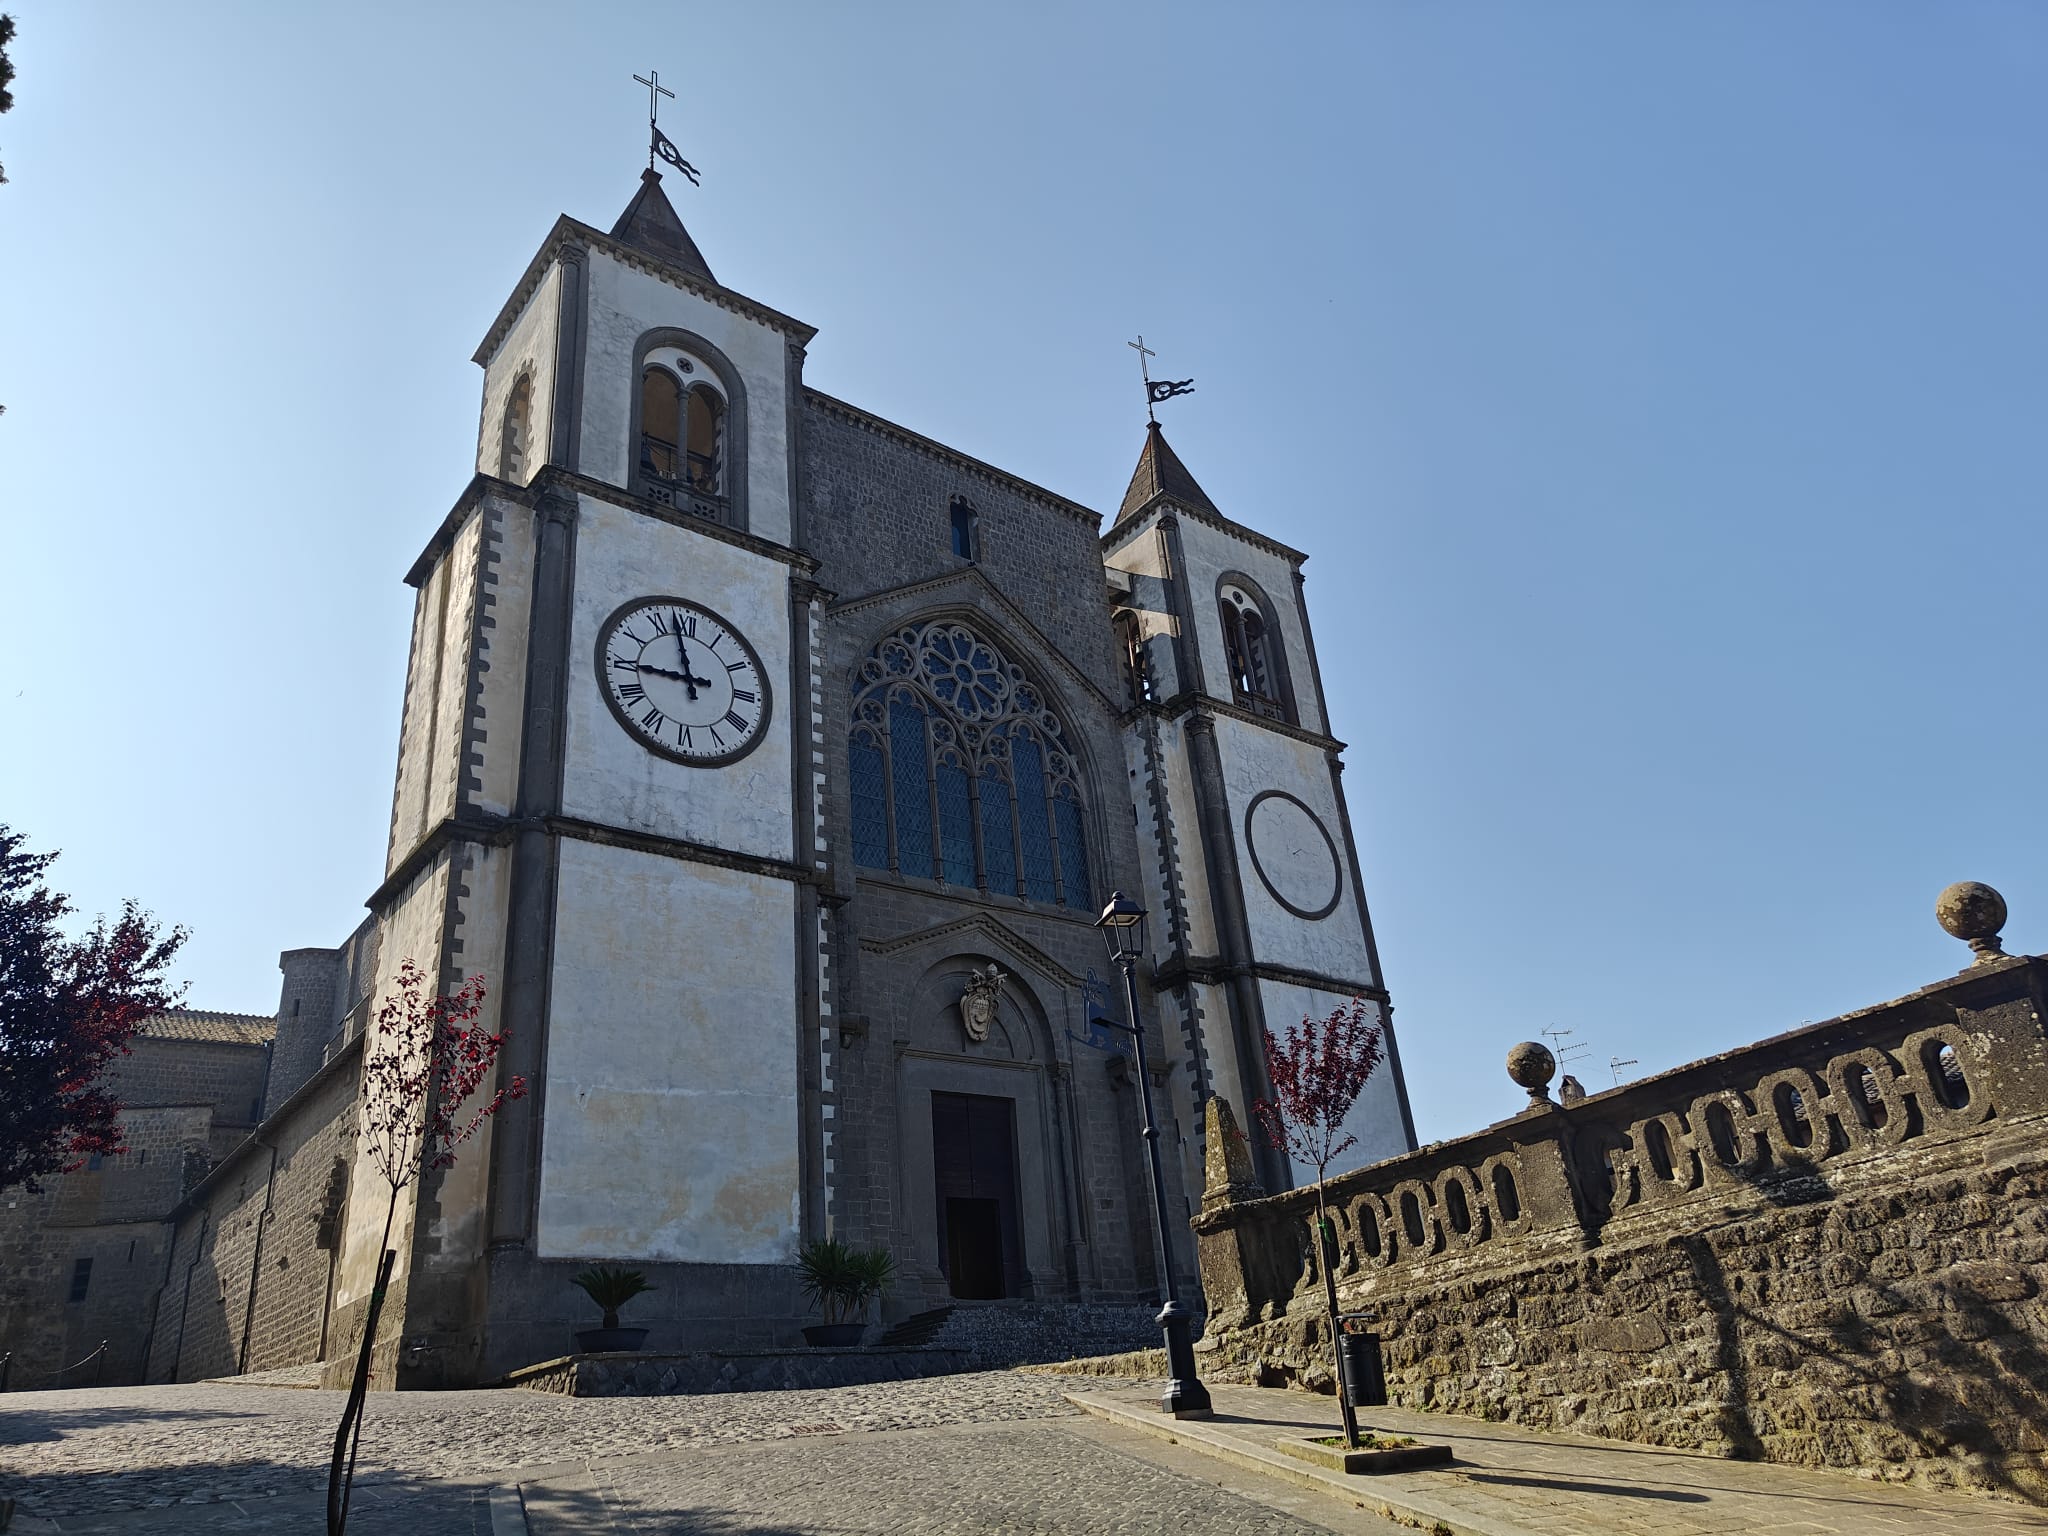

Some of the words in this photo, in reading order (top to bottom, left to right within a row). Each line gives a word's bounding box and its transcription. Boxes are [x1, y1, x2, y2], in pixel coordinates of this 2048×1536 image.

[647, 612, 668, 636] XI
[623, 627, 647, 648] X
[710, 634, 722, 649] I
[728, 661, 746, 671] II
[734, 689, 755, 703] III
[725, 711, 749, 734] IIII
[678, 724, 692, 748] VI
[710, 725, 725, 748] V
